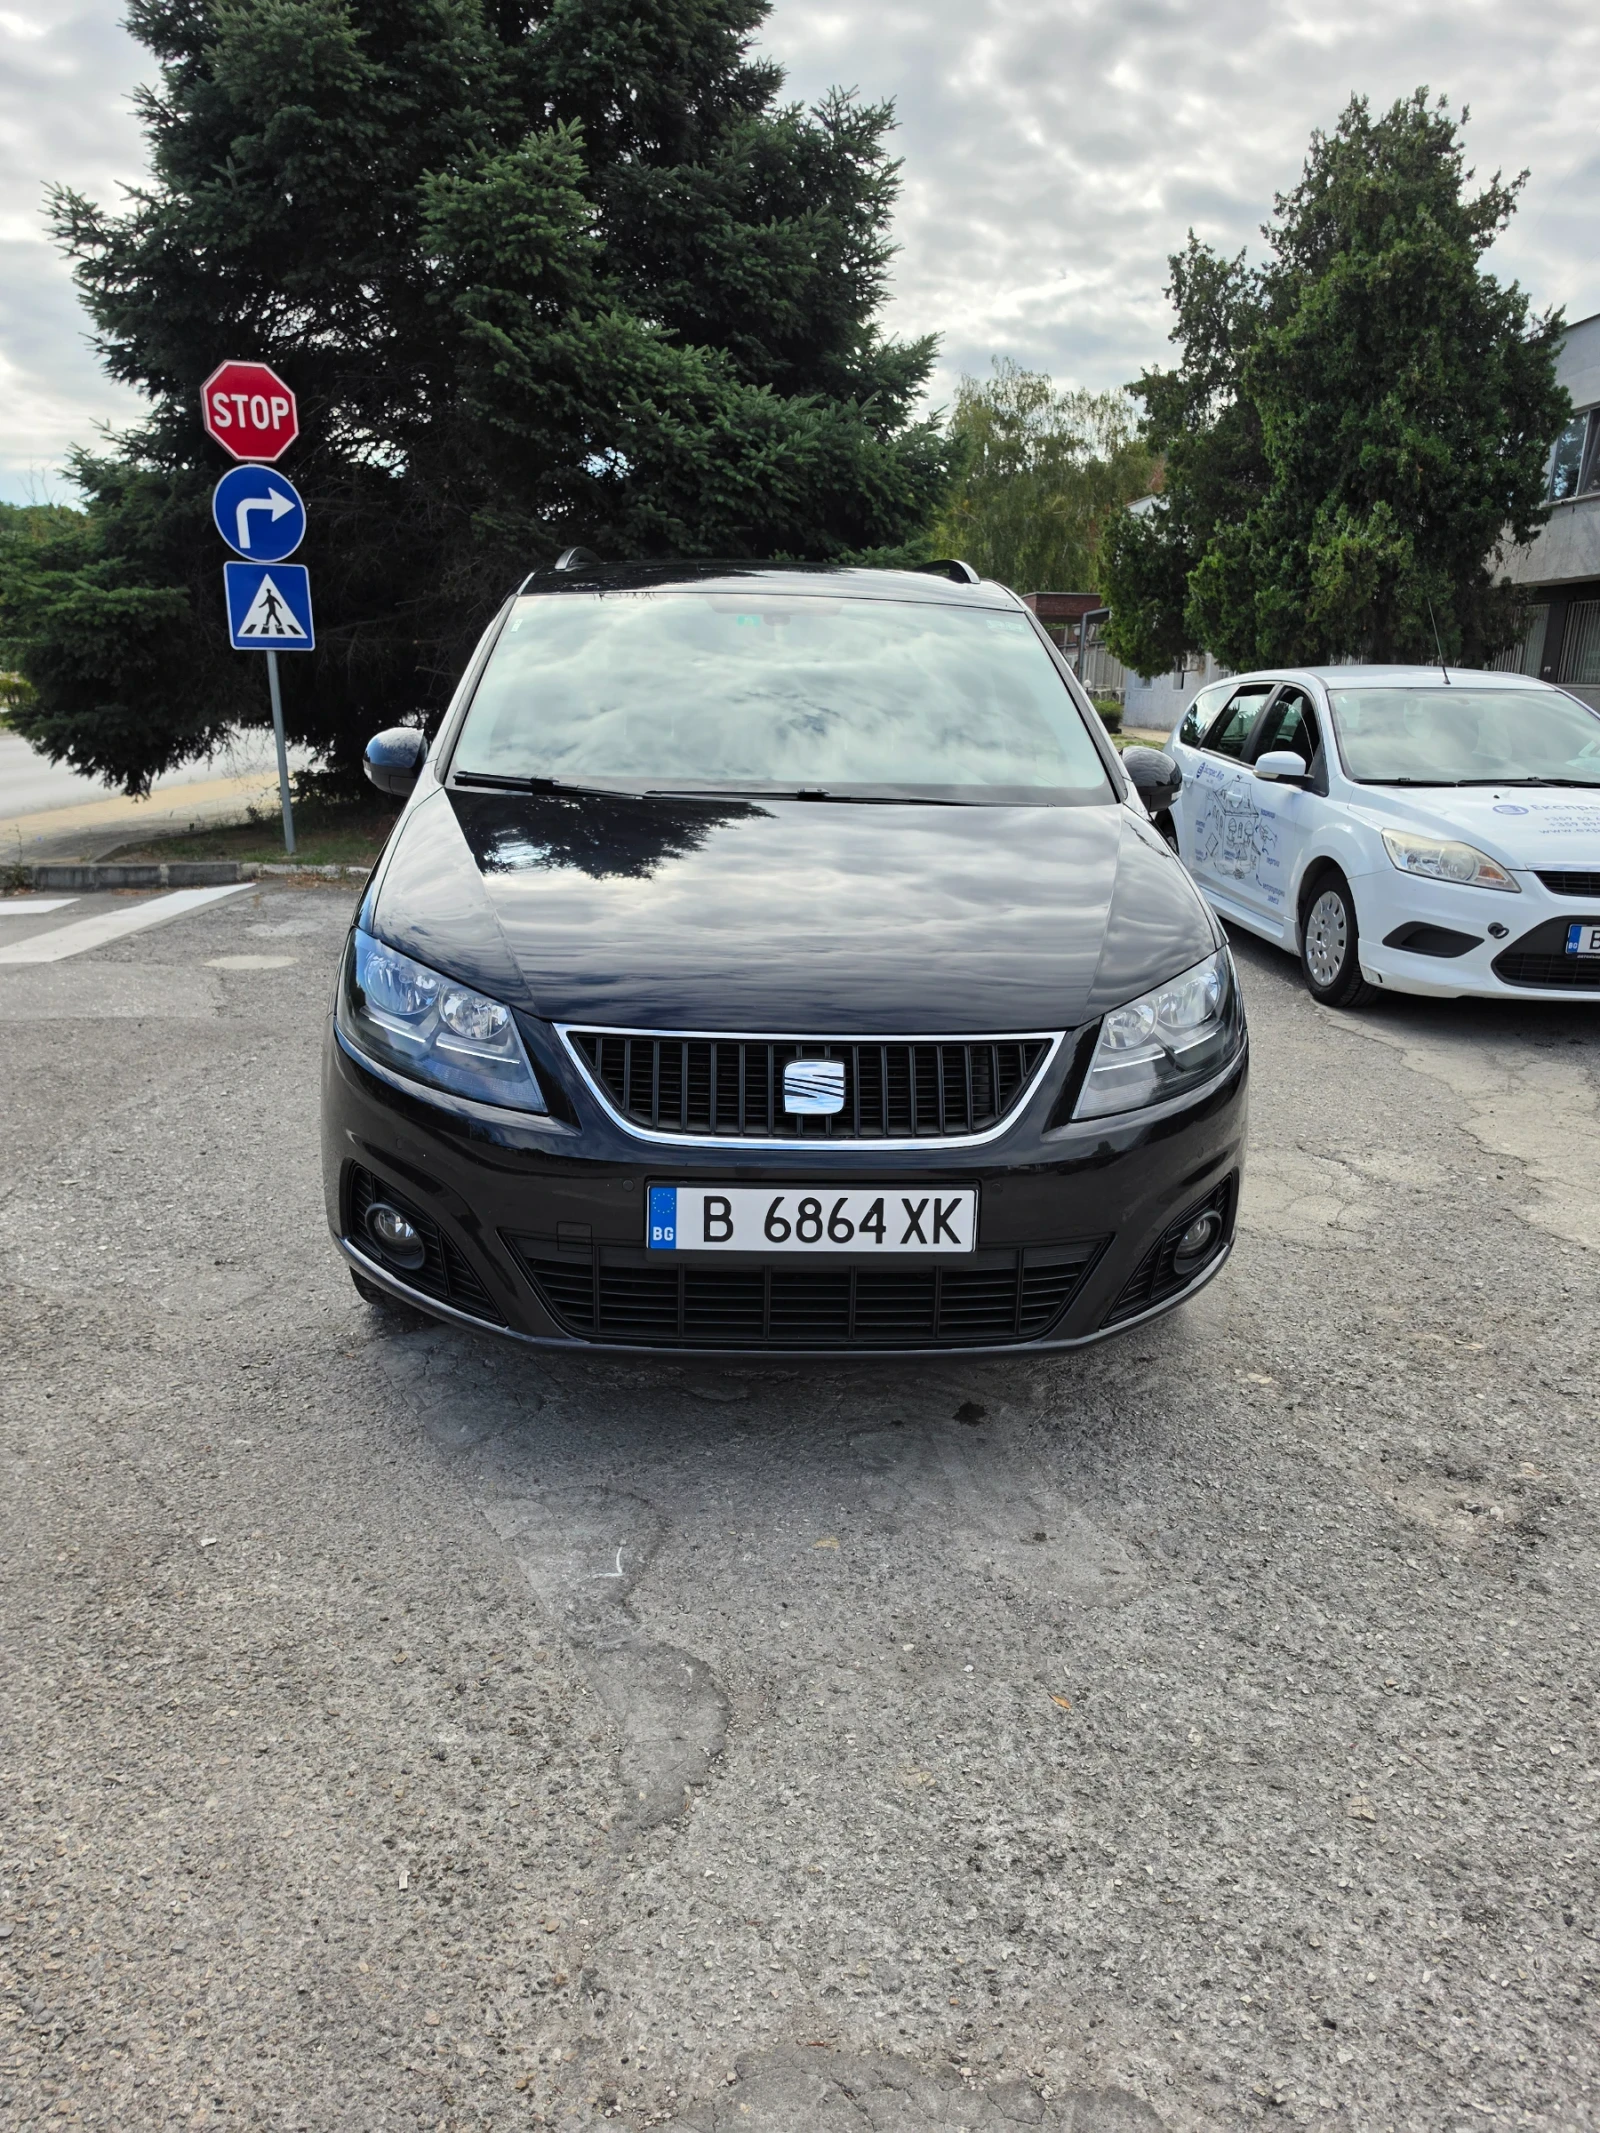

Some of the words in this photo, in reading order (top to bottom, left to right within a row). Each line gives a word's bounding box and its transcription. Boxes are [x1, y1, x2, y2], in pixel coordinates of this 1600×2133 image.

[212, 392, 290, 430] STOP
[652, 1226, 674, 1241] BG
[703, 1196, 734, 1243] B
[763, 1197, 887, 1244] 6864
[900, 1198, 963, 1245] XK
